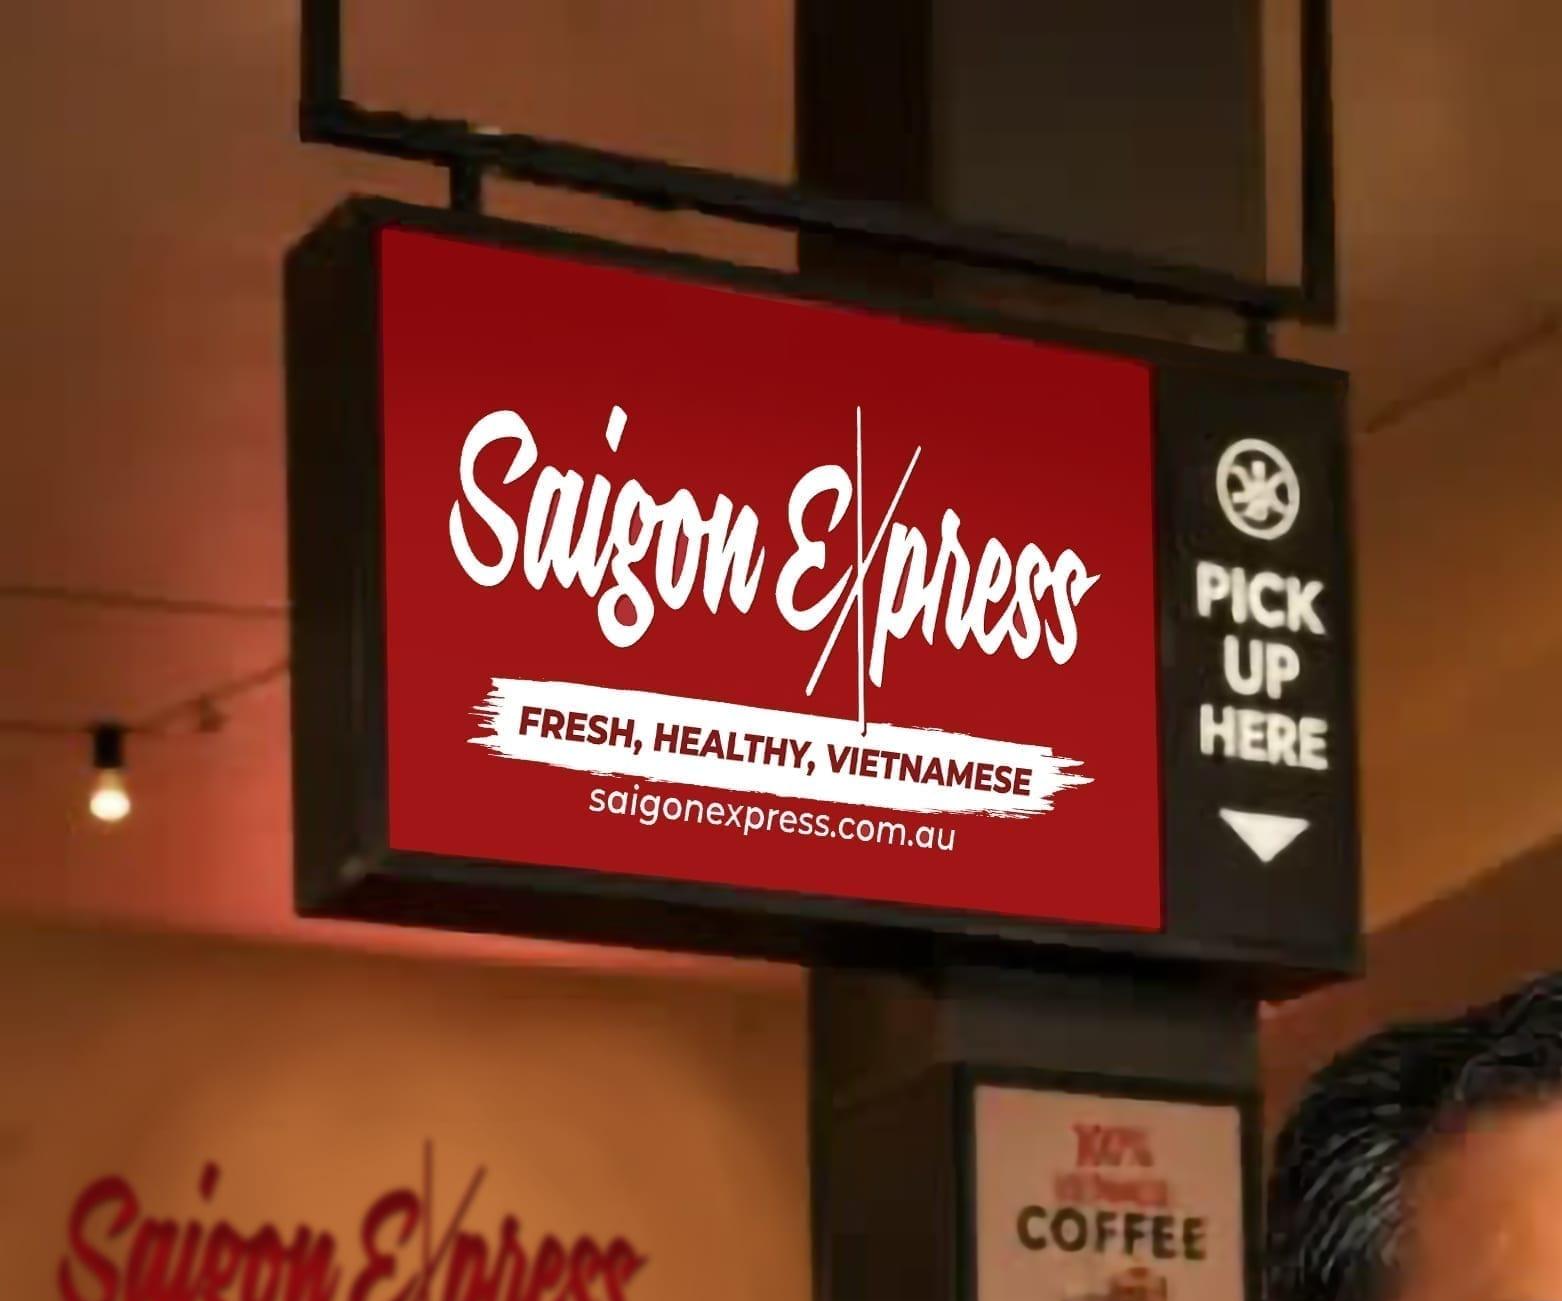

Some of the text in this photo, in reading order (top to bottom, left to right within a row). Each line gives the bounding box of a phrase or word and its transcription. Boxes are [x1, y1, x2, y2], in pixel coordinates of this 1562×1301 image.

[449, 405, 1101, 736] Saigon Express
[1196, 561, 1325, 635] PICK
[1224, 634, 1300, 699] UP
[519, 706, 1033, 797] FRESH, HEALTHY, VIETNAMESE
[1200, 703, 1328, 770] HERE
[588, 786, 956, 852] saigonexpress.com.au
[1017, 1205, 1207, 1260] COFFEE
